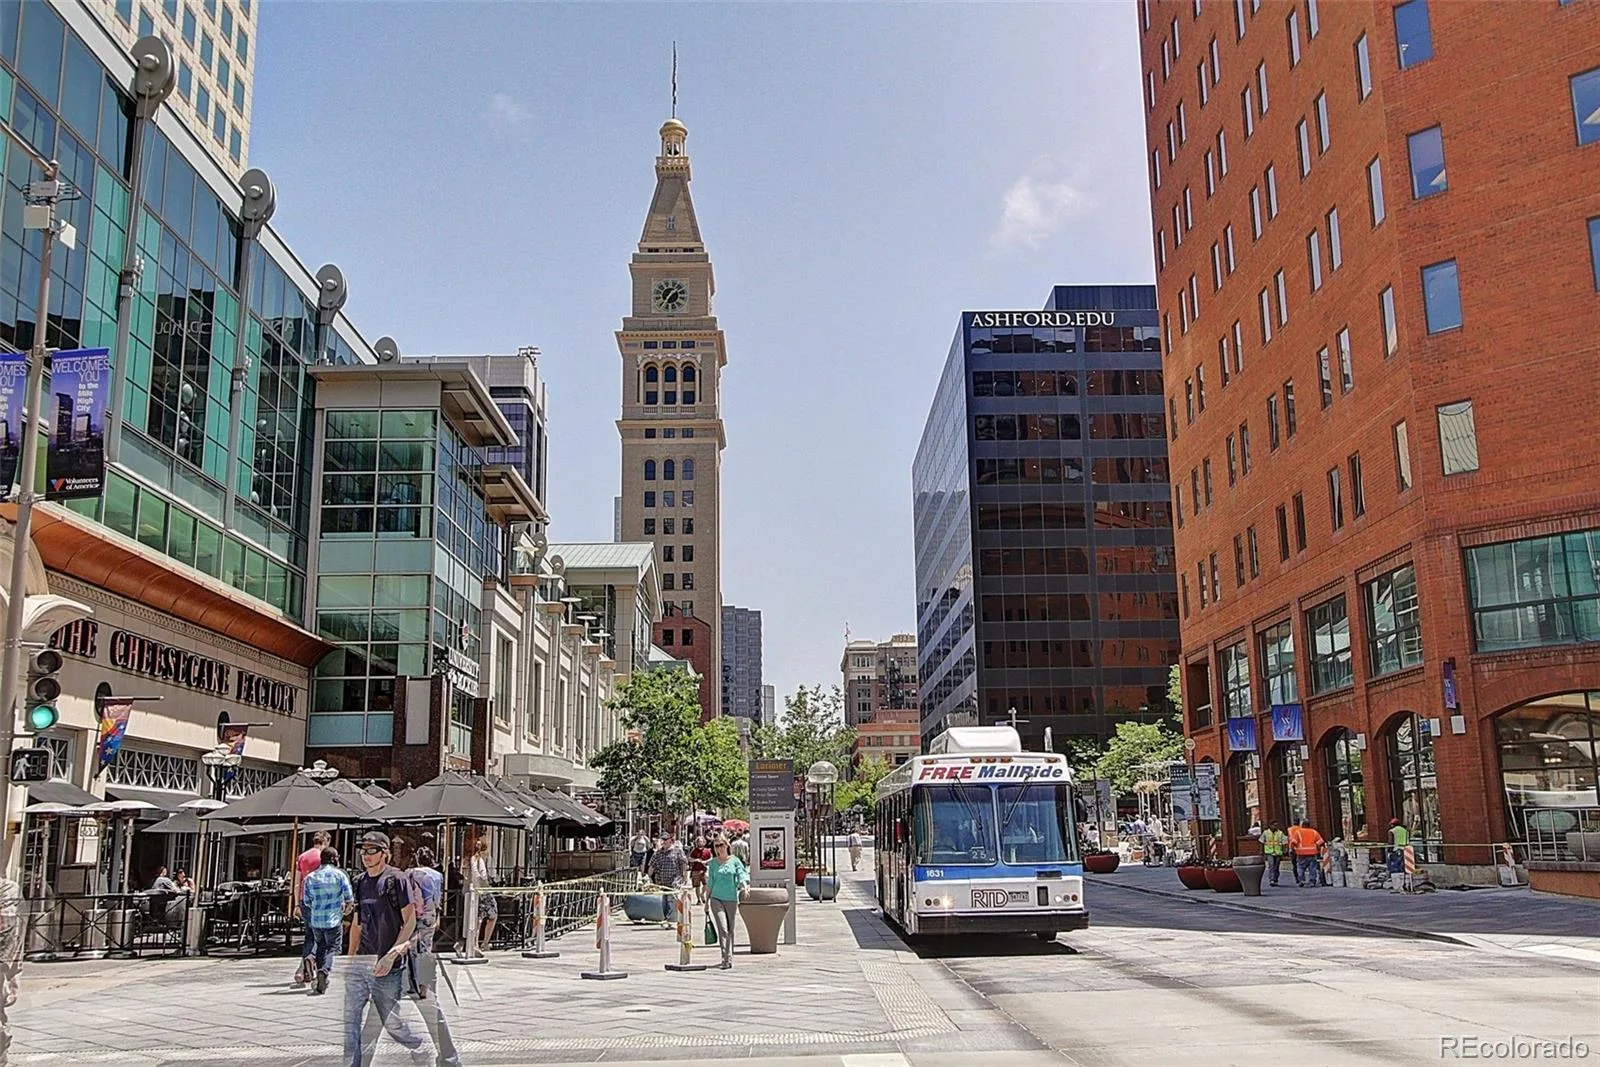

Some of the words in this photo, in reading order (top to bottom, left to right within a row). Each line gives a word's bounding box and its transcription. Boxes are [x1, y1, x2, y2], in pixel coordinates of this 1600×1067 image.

[971, 311, 1116, 328] ASHFORD.EDU
[51, 359, 110, 373] WELCOMES
[79, 370, 100, 383] YOU
[77, 397, 94, 405] High
[76, 404, 91, 412] City
[65, 477, 99, 486] Volunteers
[110, 630, 231, 695] CHEESECAKE
[237, 670, 298, 715] FACTORY
[755, 761, 787, 770] Larimer
[919, 765, 976, 780] FREE
[977, 764, 1064, 779] MallRide
[1200, 804, 1215, 817] 16
[926, 869, 945, 878] 1631
[970, 888, 1009, 908] RTD
